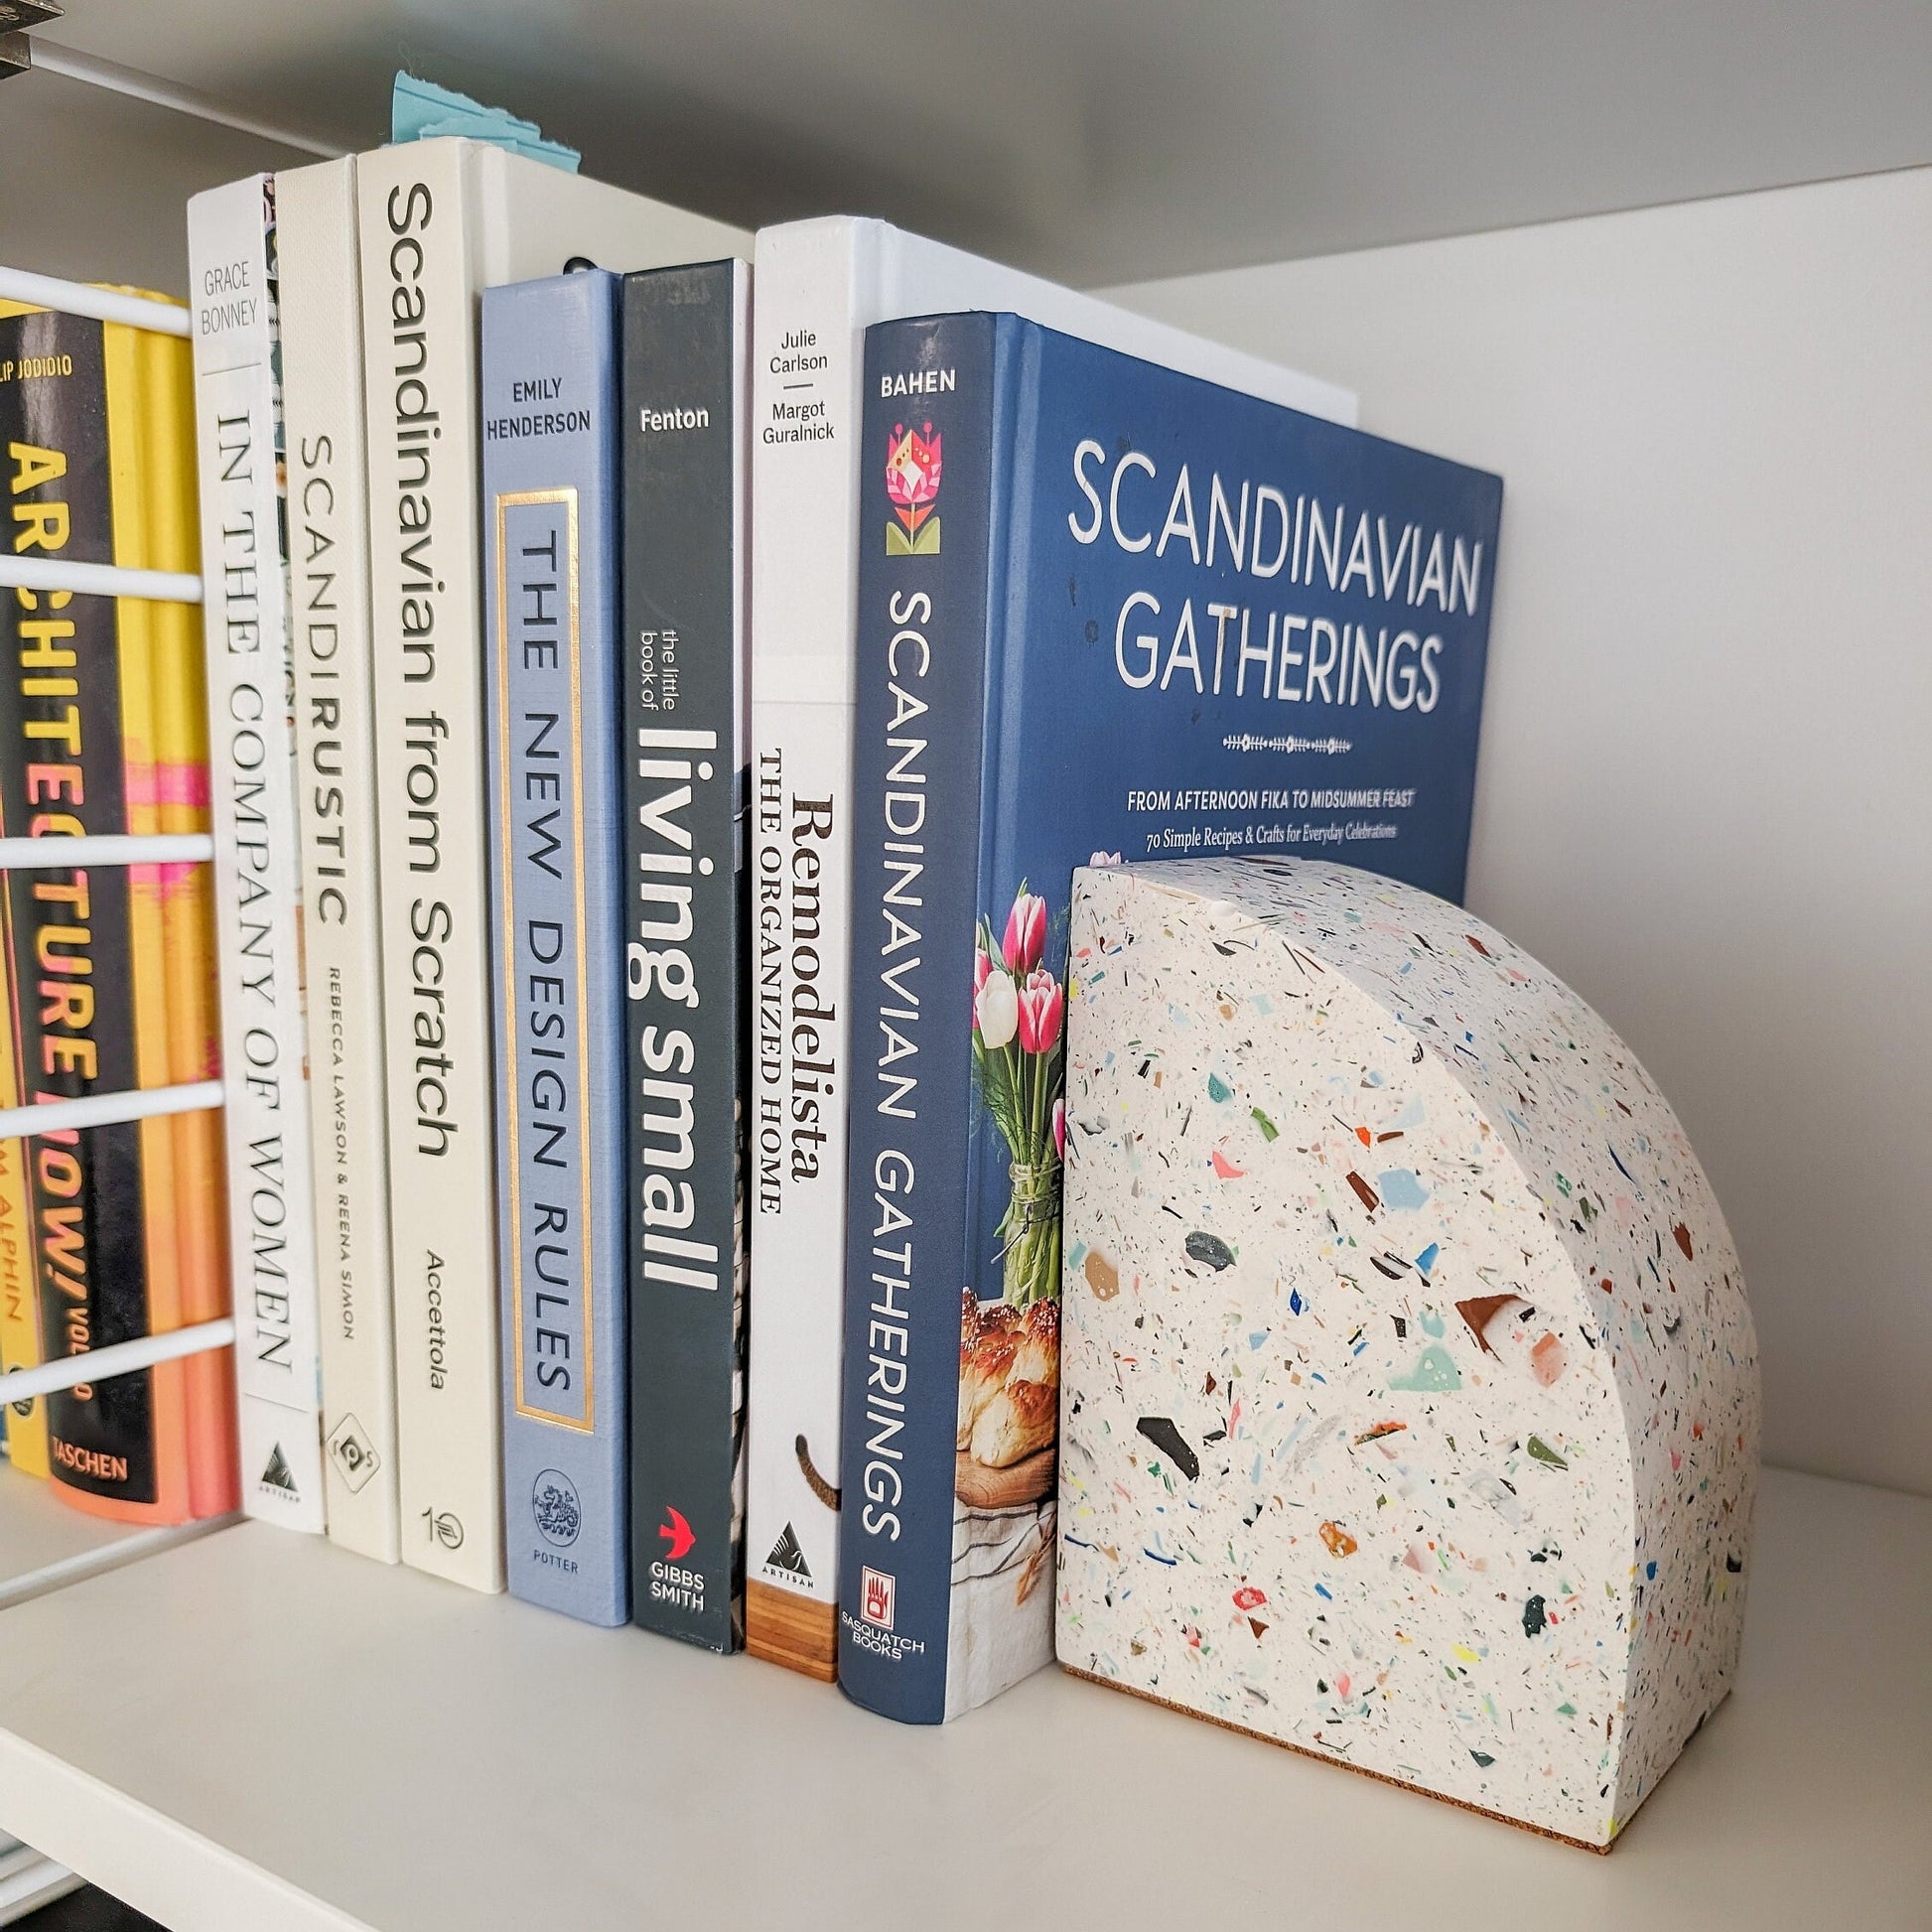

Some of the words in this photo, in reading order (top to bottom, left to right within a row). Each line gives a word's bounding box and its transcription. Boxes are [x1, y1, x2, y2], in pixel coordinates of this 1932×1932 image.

[205, 260, 251, 297] GRACE
[202, 298, 258, 336] BONNEY
[780, 330, 817, 351] Julie
[17, 354, 72, 380] JODIDIO
[513, 377, 562, 403] EMILY
[769, 351, 828, 374] Carlson
[881, 368, 956, 398] BAHEN
[217, 406, 254, 485] IN
[387, 182, 446, 684] Scandinavian
[486, 410, 592, 441] HENDERSON
[640, 405, 710, 433] Fenton
[762, 424, 835, 445] Guralnick
[772, 400, 825, 423] Margot
[1067, 439, 1484, 618] SCANDINAVIAN
[221, 509, 262, 655] THE
[522, 529, 560, 670] THE
[301, 434, 348, 925] SCANDIRUSTIC
[641, 629, 659, 685] book
[662, 627, 680, 664] the
[1114, 591, 1444, 715] GATHERINGS
[641, 689, 659, 712] of
[662, 668, 680, 711] little
[405, 710, 450, 875] from
[525, 712, 563, 881] NEW
[759, 747, 782, 834] THE
[1127, 790, 1172, 812] FROM
[1173, 790, 1258, 811] AFTERNOON
[1261, 789, 1289, 809] FIKA
[1292, 789, 1309, 808] TO
[1310, 787, 1382, 809] MIDSUMMER
[1382, 787, 1416, 808] FEAST
[229, 682, 277, 1010] COMPANY
[627, 728, 718, 1010] living
[877, 590, 933, 1120] SCANDINAVIAN
[1146, 834, 1161, 853] 70
[1163, 827, 1201, 853] Simple
[1203, 826, 1243, 852] Recipes
[1245, 826, 1254, 845] &
[1256, 824, 1285, 845] Crafts
[1287, 823, 1303, 843] for
[1303, 823, 1344, 846] Everyday
[759, 845, 782, 1085] ORGANIZED
[791, 792, 837, 1184] Remodelista
[329, 966, 344, 1067] REBECCA
[410, 897, 460, 1159] Scratch
[528, 919, 568, 1170] DESIGN
[242, 1027, 280, 1110] OF
[334, 1075, 348, 1164] LAWSON
[338, 1173, 348, 1185] &
[641, 1024, 720, 1292] small
[759, 1096, 782, 1216] HOME
[248, 1132, 294, 1375] WOMEN
[339, 1194, 350, 1262] REENA
[342, 1269, 354, 1340] SIMON
[426, 1248, 449, 1391] Accettola
[534, 1202, 572, 1392] RULES
[861, 1149, 915, 1544] GATHERINGS
[53, 1435, 128, 1481] TASCHEN
[533, 1549, 579, 1575] POTTER
[651, 1561, 706, 1590] GIBBS
[651, 1581, 705, 1611] SMITH
[761, 1566, 815, 1589] ARTISAN
[841, 1610, 926, 1655] SASQUATCH
[852, 1631, 903, 1661] BOOKS
